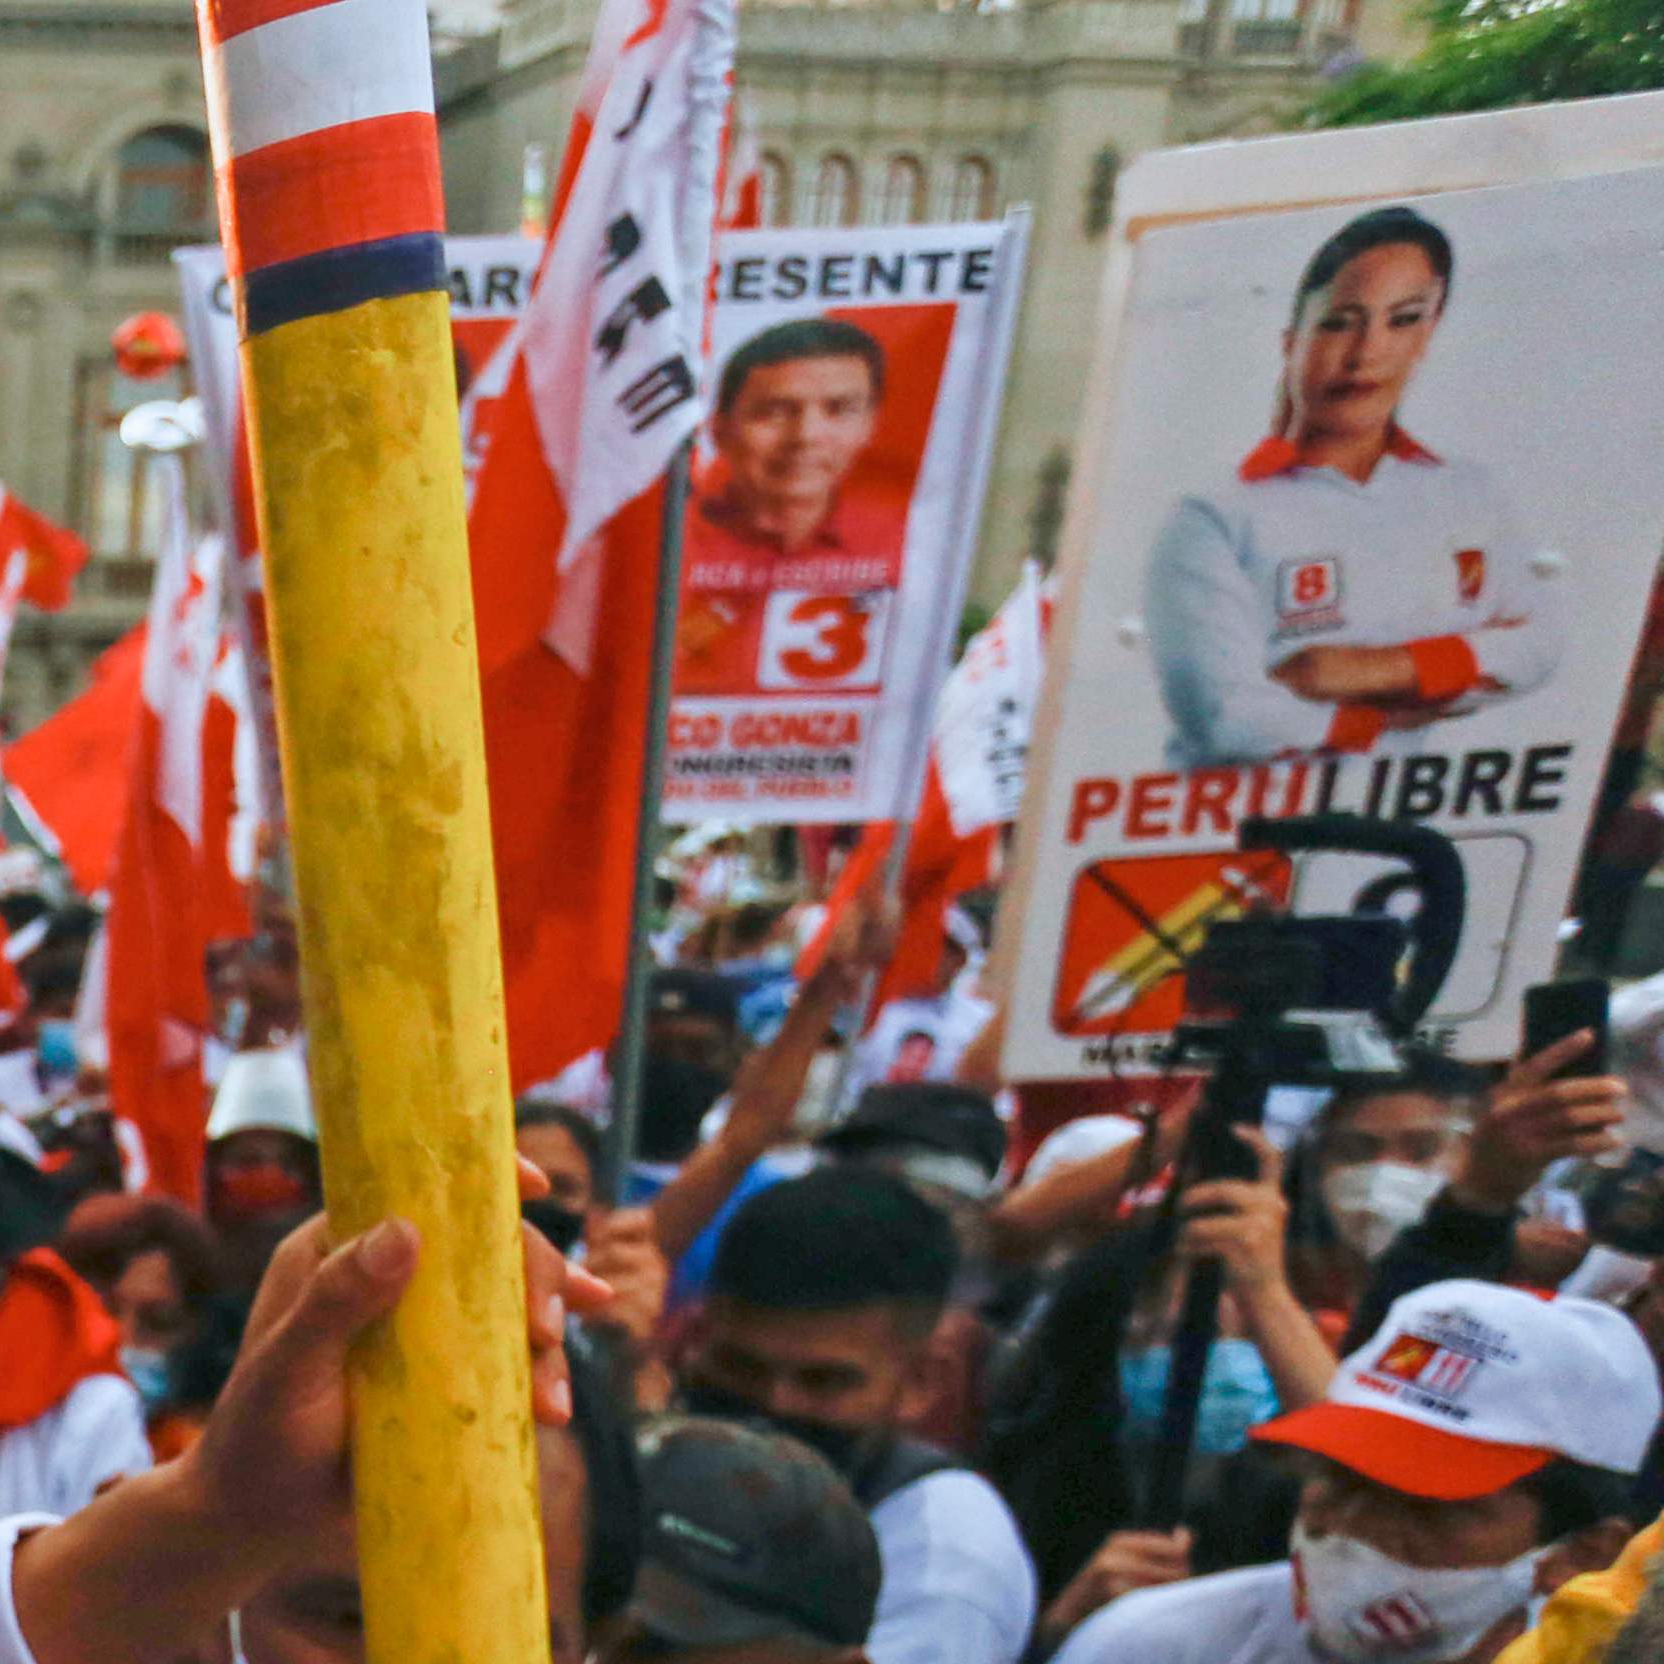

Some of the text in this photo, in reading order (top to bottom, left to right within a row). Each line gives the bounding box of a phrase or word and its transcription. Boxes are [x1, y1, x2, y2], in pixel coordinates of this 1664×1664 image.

[709, 248, 995, 302] ESENTE
[777, 597, 871, 680] 3
[1311, 743, 1573, 824] LIBRE
